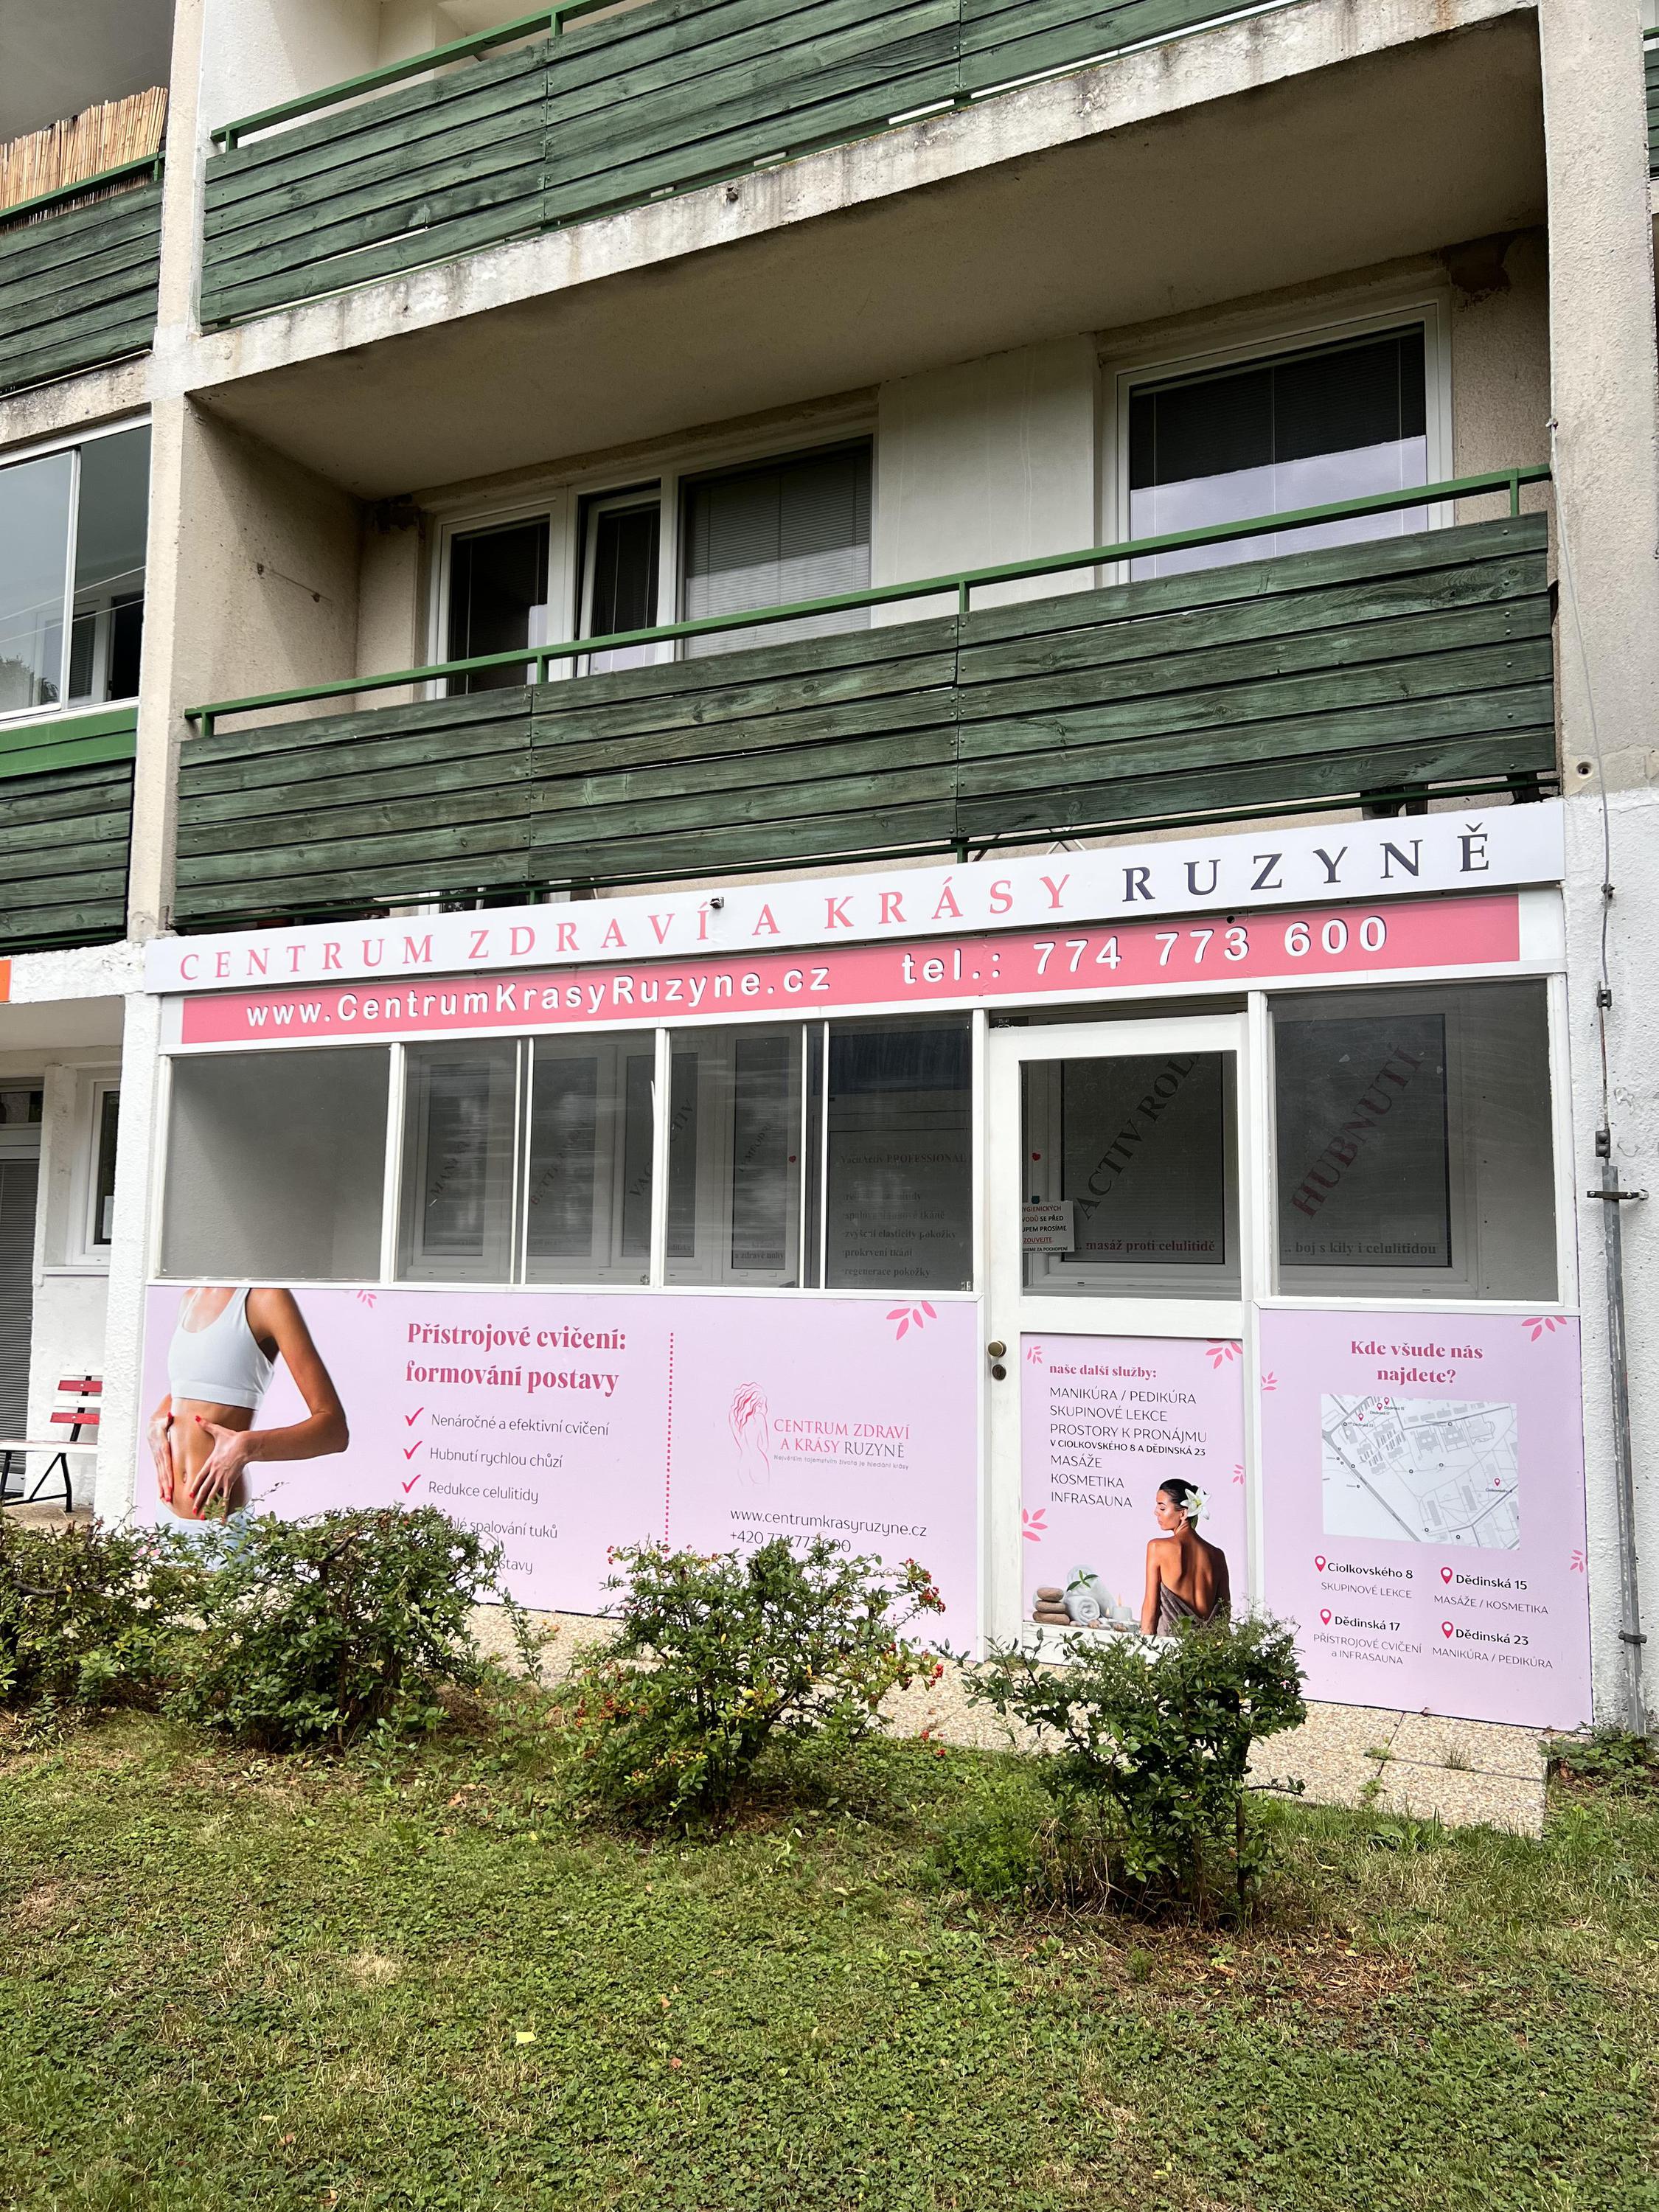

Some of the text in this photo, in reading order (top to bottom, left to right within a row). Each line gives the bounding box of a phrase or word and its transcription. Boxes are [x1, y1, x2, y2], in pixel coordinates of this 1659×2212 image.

[179, 821, 1491, 982] CENTRUM ZDRAVÍ A KRÁSY RUZYNĚ
[246, 915, 1388, 1027] www.CentrumKrasyRuzyne.cz tel.: 774 773 600
[1076, 1054, 1203, 1221] ACTIV ROL
[1023, 1204, 1062, 1213] YGIENICKÝCH
[1048, 1214, 1064, 1222] PŘED
[1040, 1224, 1067, 1232] PROSÍME
[1086, 1239, 1122, 1251] masáž
[1126, 1240, 1156, 1253] proti
[1158, 1239, 1215, 1252] celulitidě
[1295, 1242, 1316, 1255] boj
[1320, 1245, 1326, 1253] s
[1329, 1242, 1354, 1256] kily
[1357, 1242, 1363, 1253] i
[1366, 1242, 1437, 1254] celulitidou
[407, 1323, 626, 1352] Přístrojové cvičení:
[1351, 1340, 1484, 1360] Kde všude nás
[406, 1360, 619, 1397] formování postavy
[1049, 1364, 1157, 1381] naše další služby:
[1377, 1366, 1457, 1386] najdete?
[1049, 1385, 1118, 1401] MANIKÚRA
[1130, 1389, 1197, 1405] PEDIKÚRA
[1049, 1405, 1168, 1422] SKUPINOVÉ LEKCE
[431, 1413, 610, 1436] Nenáročné a efektivní cvičení
[774, 1419, 911, 1440] CENTRUM ZDRAVÍ
[1050, 1423, 1208, 1444] PROSTORY K PRONÁJMU
[780, 1437, 905, 1458] A KRÁSY RUZYNĚ
[1057, 1439, 1127, 1452] CIOLKOVSKÉHO
[1130, 1444, 1135, 1452] 8
[1137, 1444, 1144, 1453] A
[1146, 1444, 1192, 1455] DĚDINSKÁ
[1194, 1447, 1206, 1457] 23
[430, 1447, 563, 1469] Hubnutí rychlou chůzí
[1051, 1453, 1103, 1468] MASÁŽE
[1051, 1473, 1125, 1488] KOSMETIKA
[428, 1481, 539, 1505] Redukce celulitidy
[1051, 1491, 1133, 1508] INFRASAUNA
[470, 1520, 527, 1537] spalování
[529, 1523, 558, 1540] tuků
[730, 1509, 928, 1537] www.centrumkrasyruzyne.cz
[730, 1530, 764, 1545] +420
[500, 1558, 533, 1576] stavy
[1327, 1562, 1413, 1579] Ciolkovského 8
[1321, 1582, 1412, 1599] SKUPINOVÉ LEKCE
[1455, 1573, 1528, 1590] Dědinská 15
[1433, 1594, 1477, 1608] MASÁŽE
[1486, 1600, 1549, 1615] KOSMETIKA
[1335, 1615, 1400, 1632] Dědinská 17
[1313, 1632, 1422, 1654] PŘÍSTROJOVÉ CVIČENÍ
[1455, 1628, 1529, 1646] Dědinská 23
[1339, 1650, 1403, 1665] INFRASAUNA
[1433, 1646, 1489, 1661] MANIKÚRA
[1498, 1653, 1553, 1669] PEDIKÚRA
